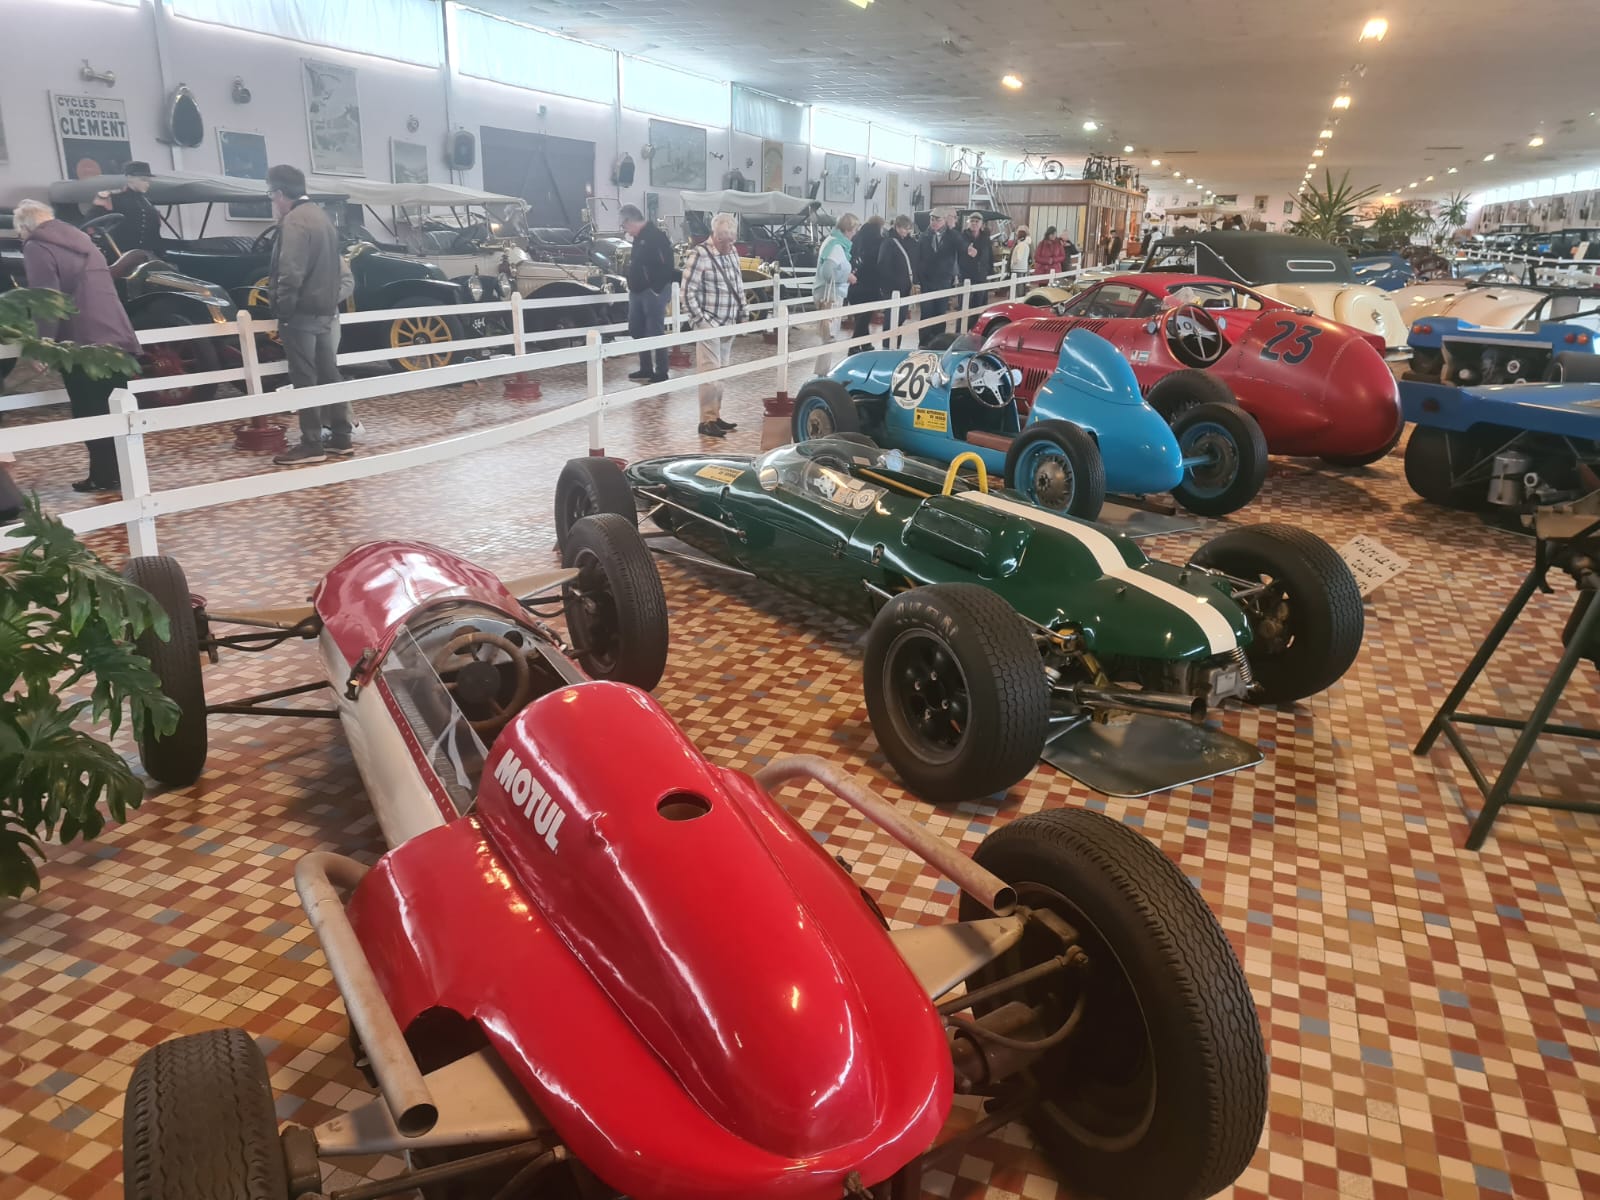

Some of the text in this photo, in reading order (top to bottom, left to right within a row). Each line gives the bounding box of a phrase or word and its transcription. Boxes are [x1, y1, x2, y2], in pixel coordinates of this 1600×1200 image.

[58, 97, 96, 108] CYCLES
[68, 109, 120, 119] MOTOCYCLES
[1259, 320, 1323, 365] 23
[893, 362, 930, 400] 26
[494, 748, 567, 852] MOTUL
